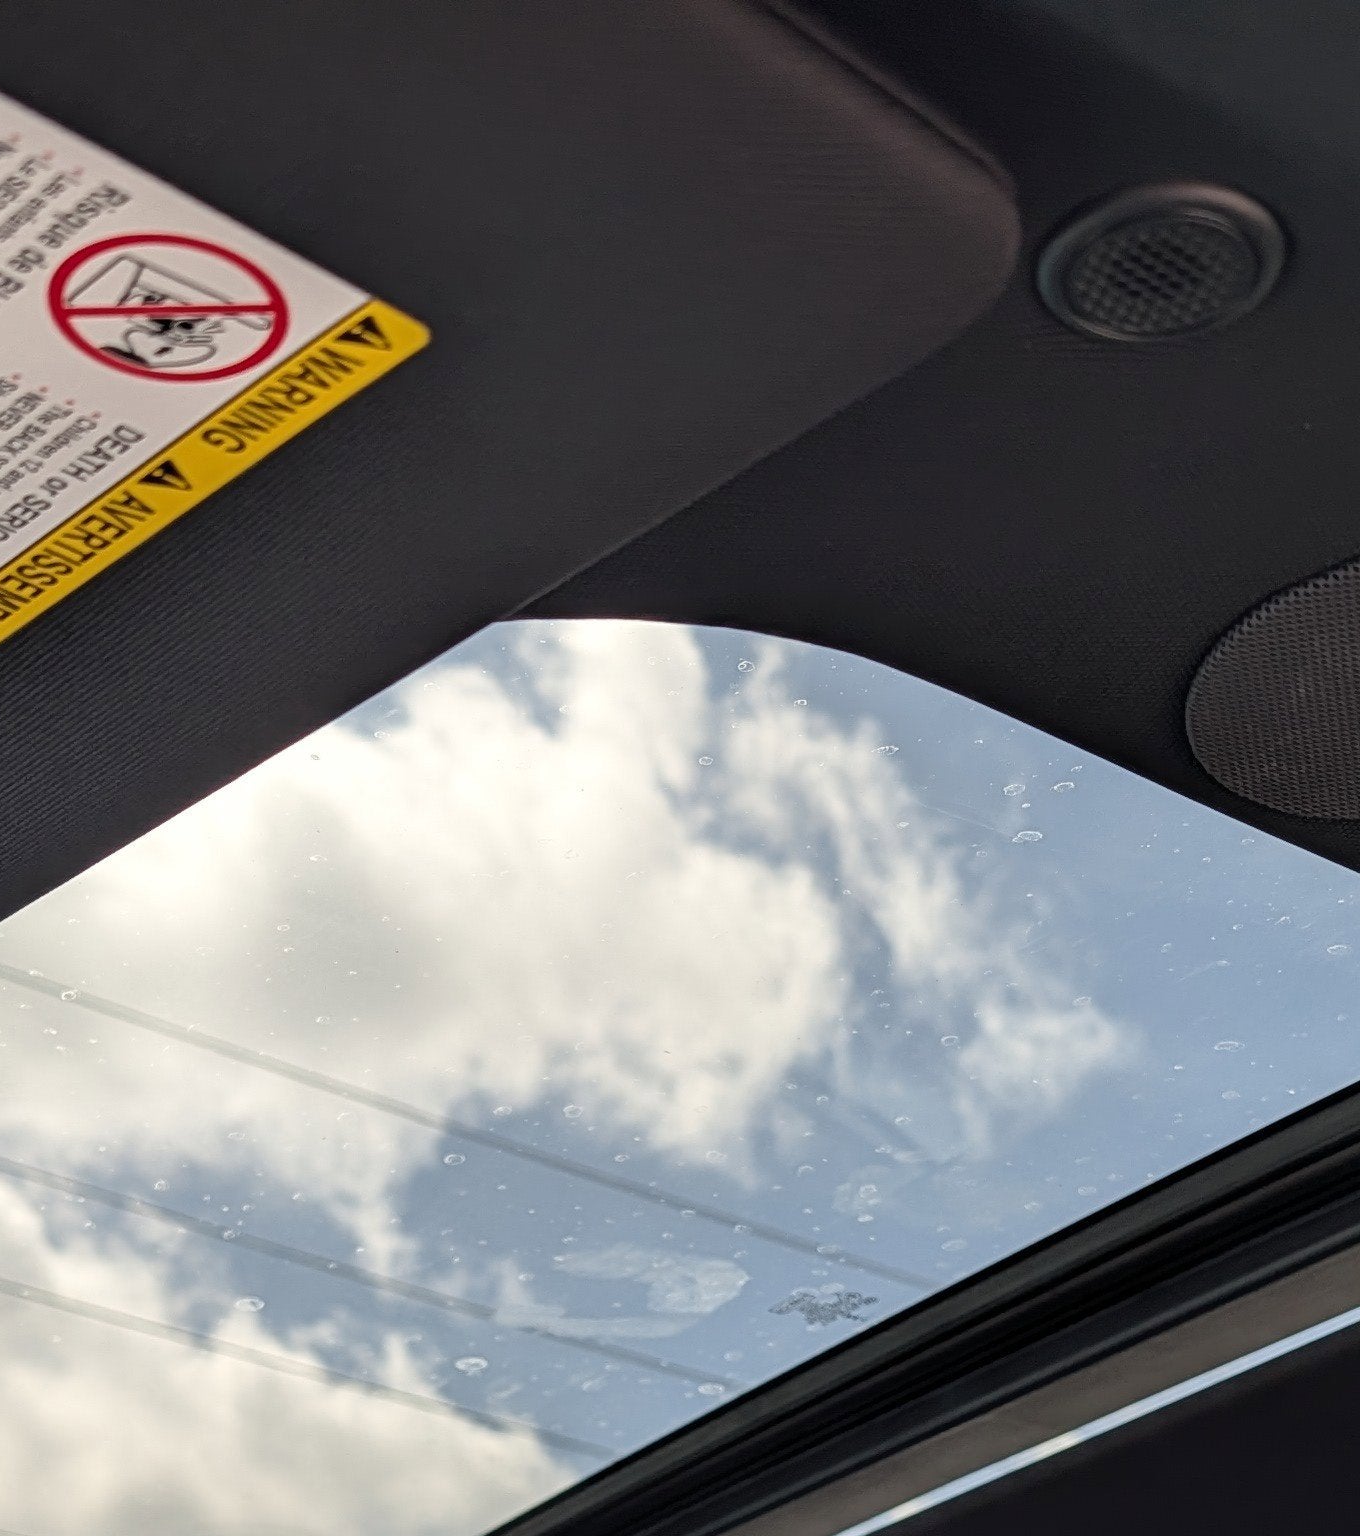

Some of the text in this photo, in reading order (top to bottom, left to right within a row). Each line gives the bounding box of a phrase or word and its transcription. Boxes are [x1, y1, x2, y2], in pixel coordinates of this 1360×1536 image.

[35, 182, 132, 249] Risque
[6, 246, 46, 274] de
[34, 404, 74, 426] The
[199, 346, 364, 454] WARNING
[33, 414, 98, 459] Children
[60, 423, 145, 482] DEATH
[38, 475, 69, 498] or
